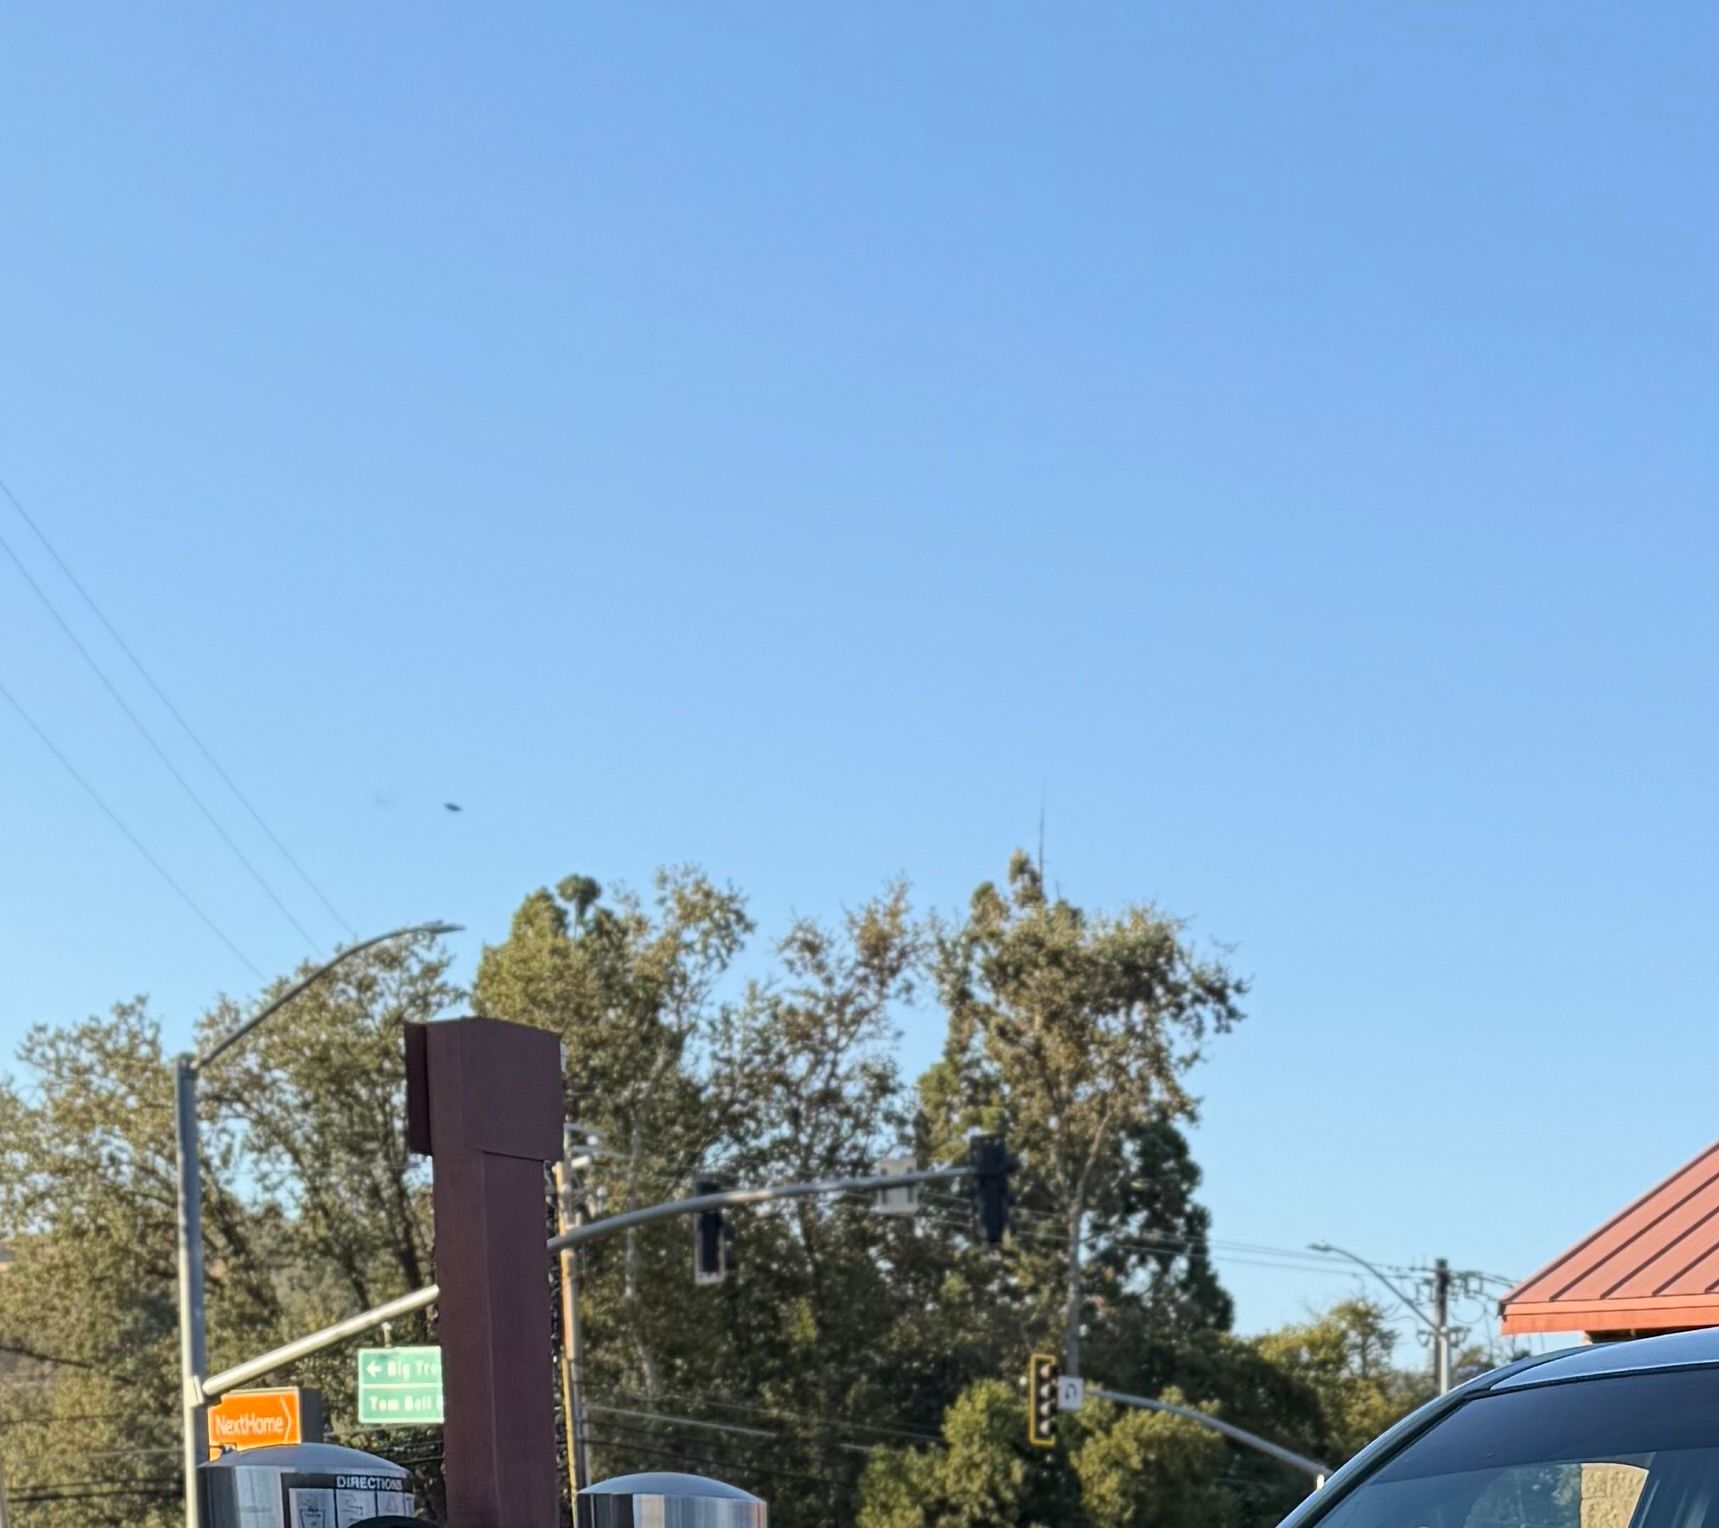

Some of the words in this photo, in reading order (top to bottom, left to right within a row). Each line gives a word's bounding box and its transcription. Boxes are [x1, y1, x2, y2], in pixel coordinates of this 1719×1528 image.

[387, 1360, 411, 1380] Big
[369, 1395, 400, 1412] Tom
[215, 1411, 284, 1436] NextHome
[336, 1476, 403, 1491] DIRECTIONS
